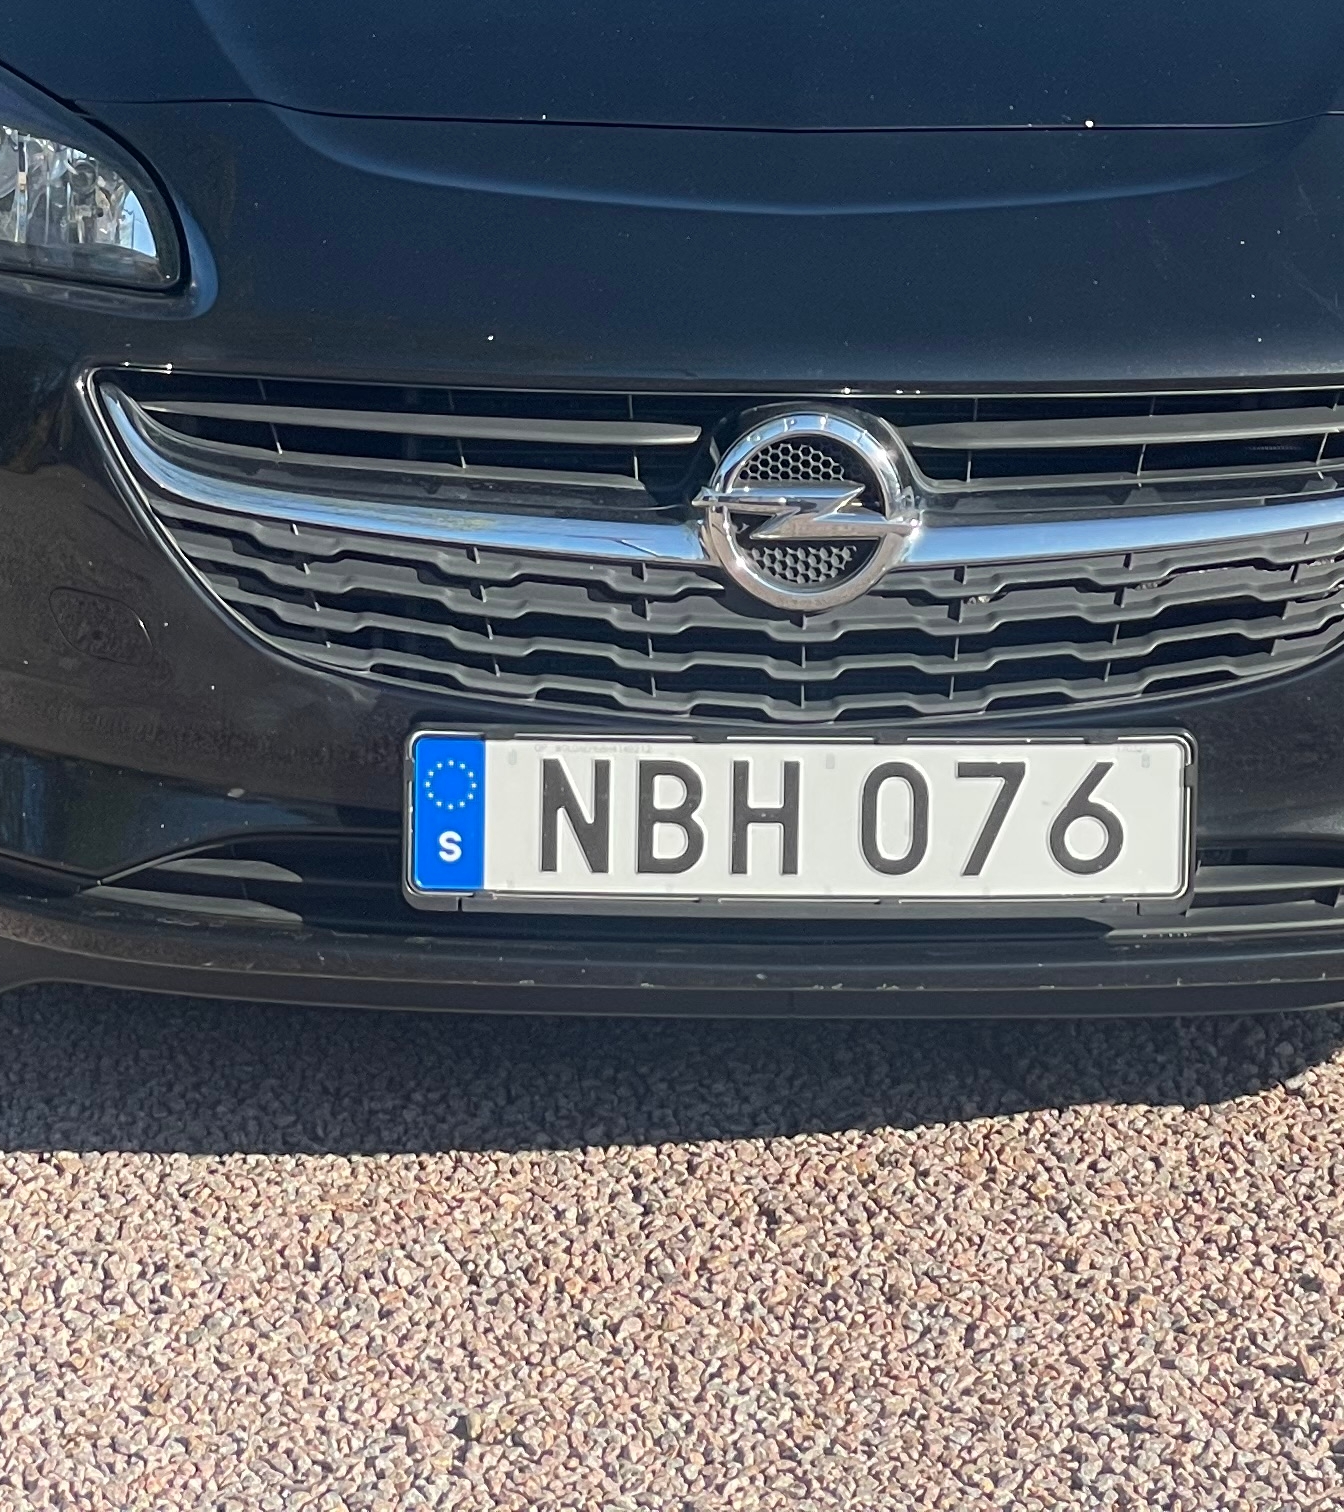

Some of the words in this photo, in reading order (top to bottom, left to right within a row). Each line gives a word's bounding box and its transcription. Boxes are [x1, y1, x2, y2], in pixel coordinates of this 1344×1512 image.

[438, 830, 462, 862] S
[539, 758, 800, 875] NBH
[860, 761, 1124, 876] 076
